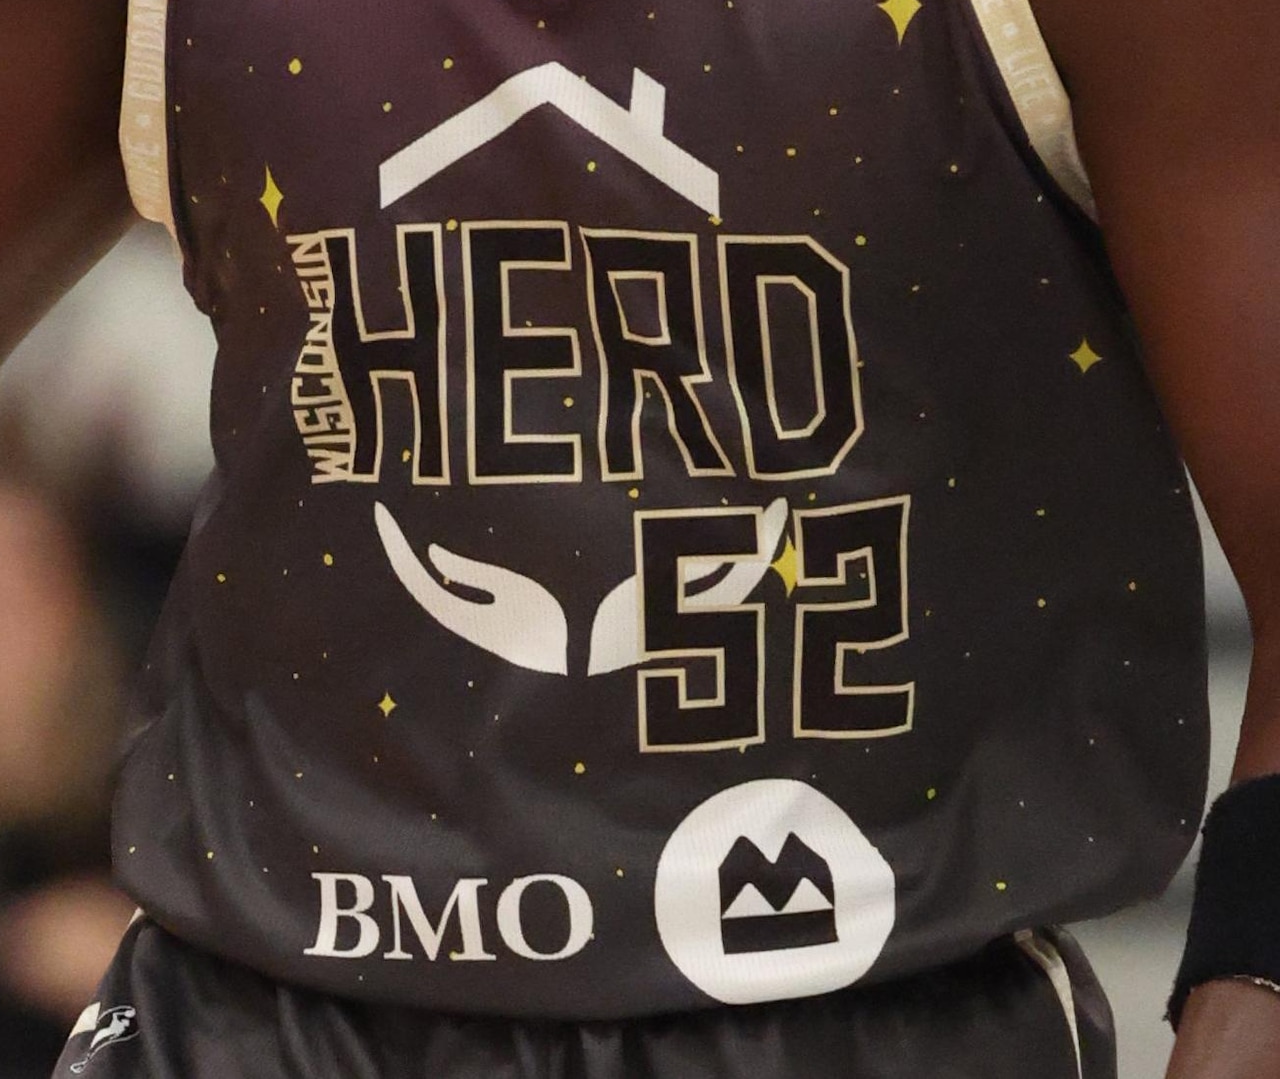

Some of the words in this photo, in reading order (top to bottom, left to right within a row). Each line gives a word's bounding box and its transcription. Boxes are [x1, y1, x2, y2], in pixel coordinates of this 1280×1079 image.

[1008, 47, 1058, 110] LIFE
[285, 231, 357, 484] WISCONSIN
[318, 220, 865, 486] HERD
[633, 494, 915, 754] 52
[303, 872, 594, 961] BMO
